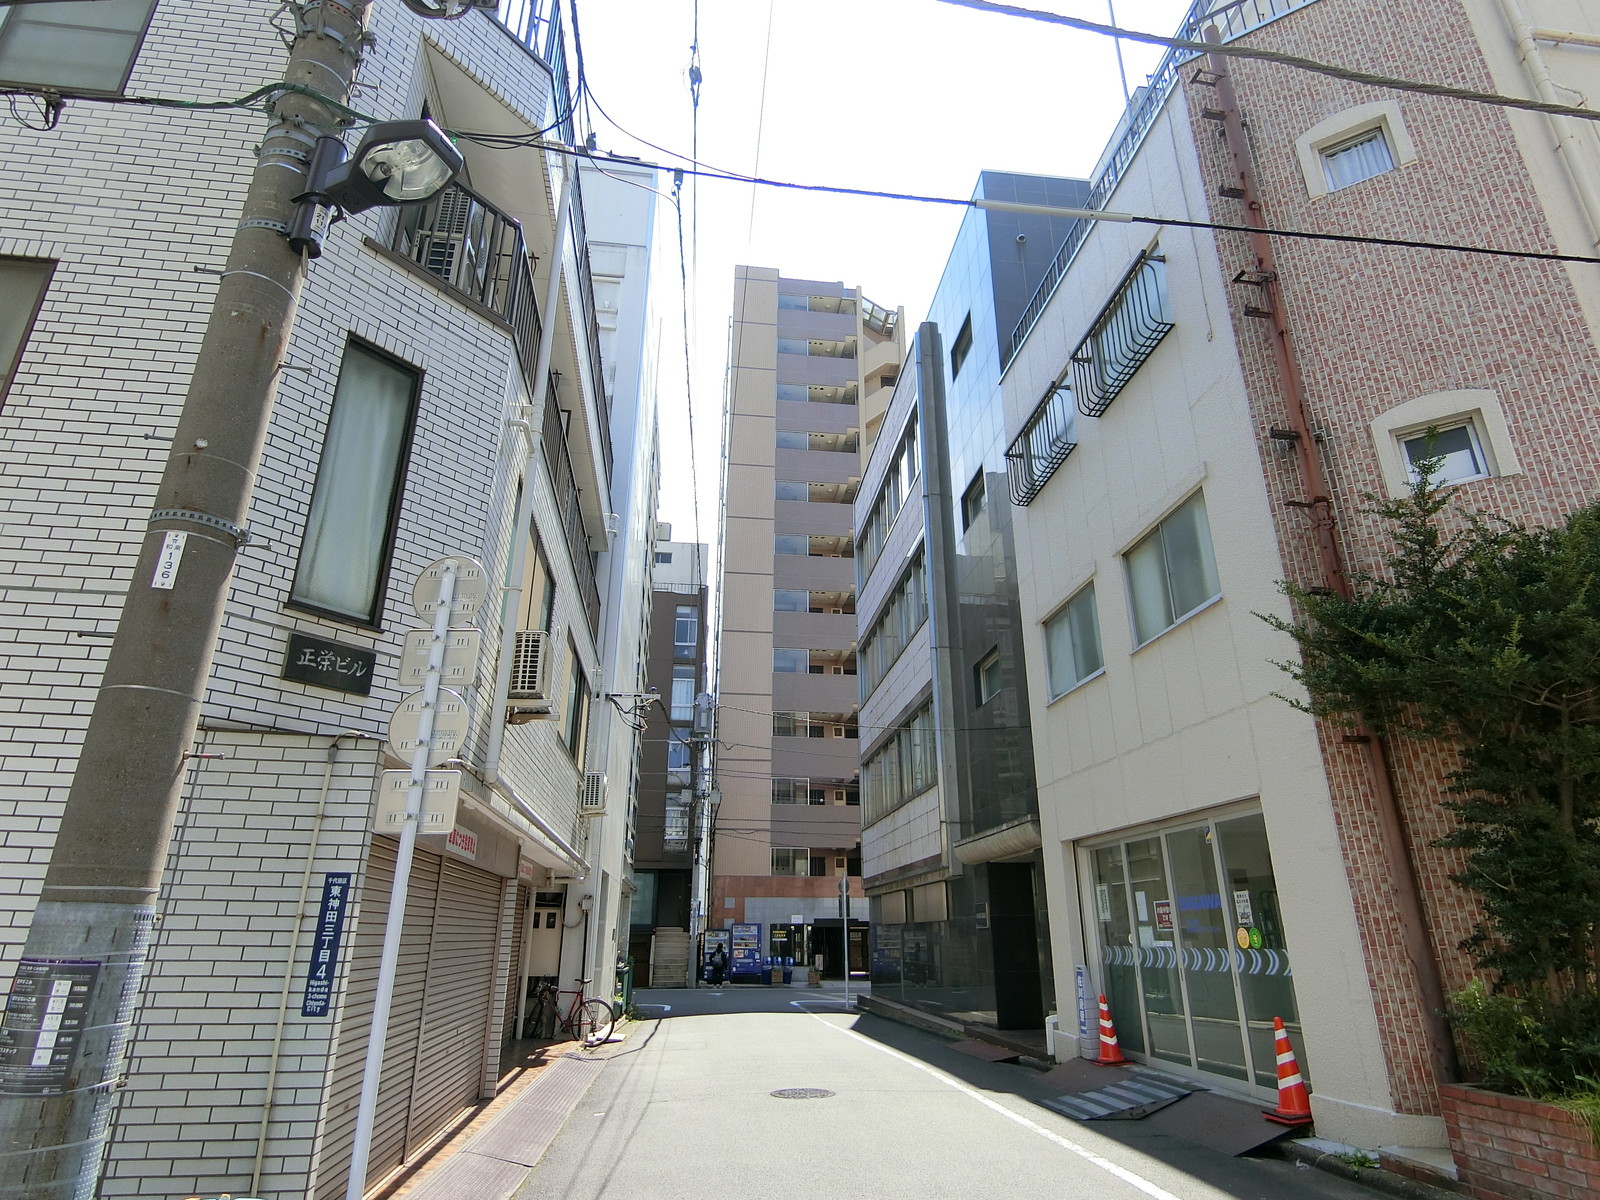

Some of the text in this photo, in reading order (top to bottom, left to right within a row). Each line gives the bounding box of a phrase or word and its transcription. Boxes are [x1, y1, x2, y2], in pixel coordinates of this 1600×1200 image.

[161, 552, 173, 579] 136
[296, 648, 367, 677] 正栄ビル
